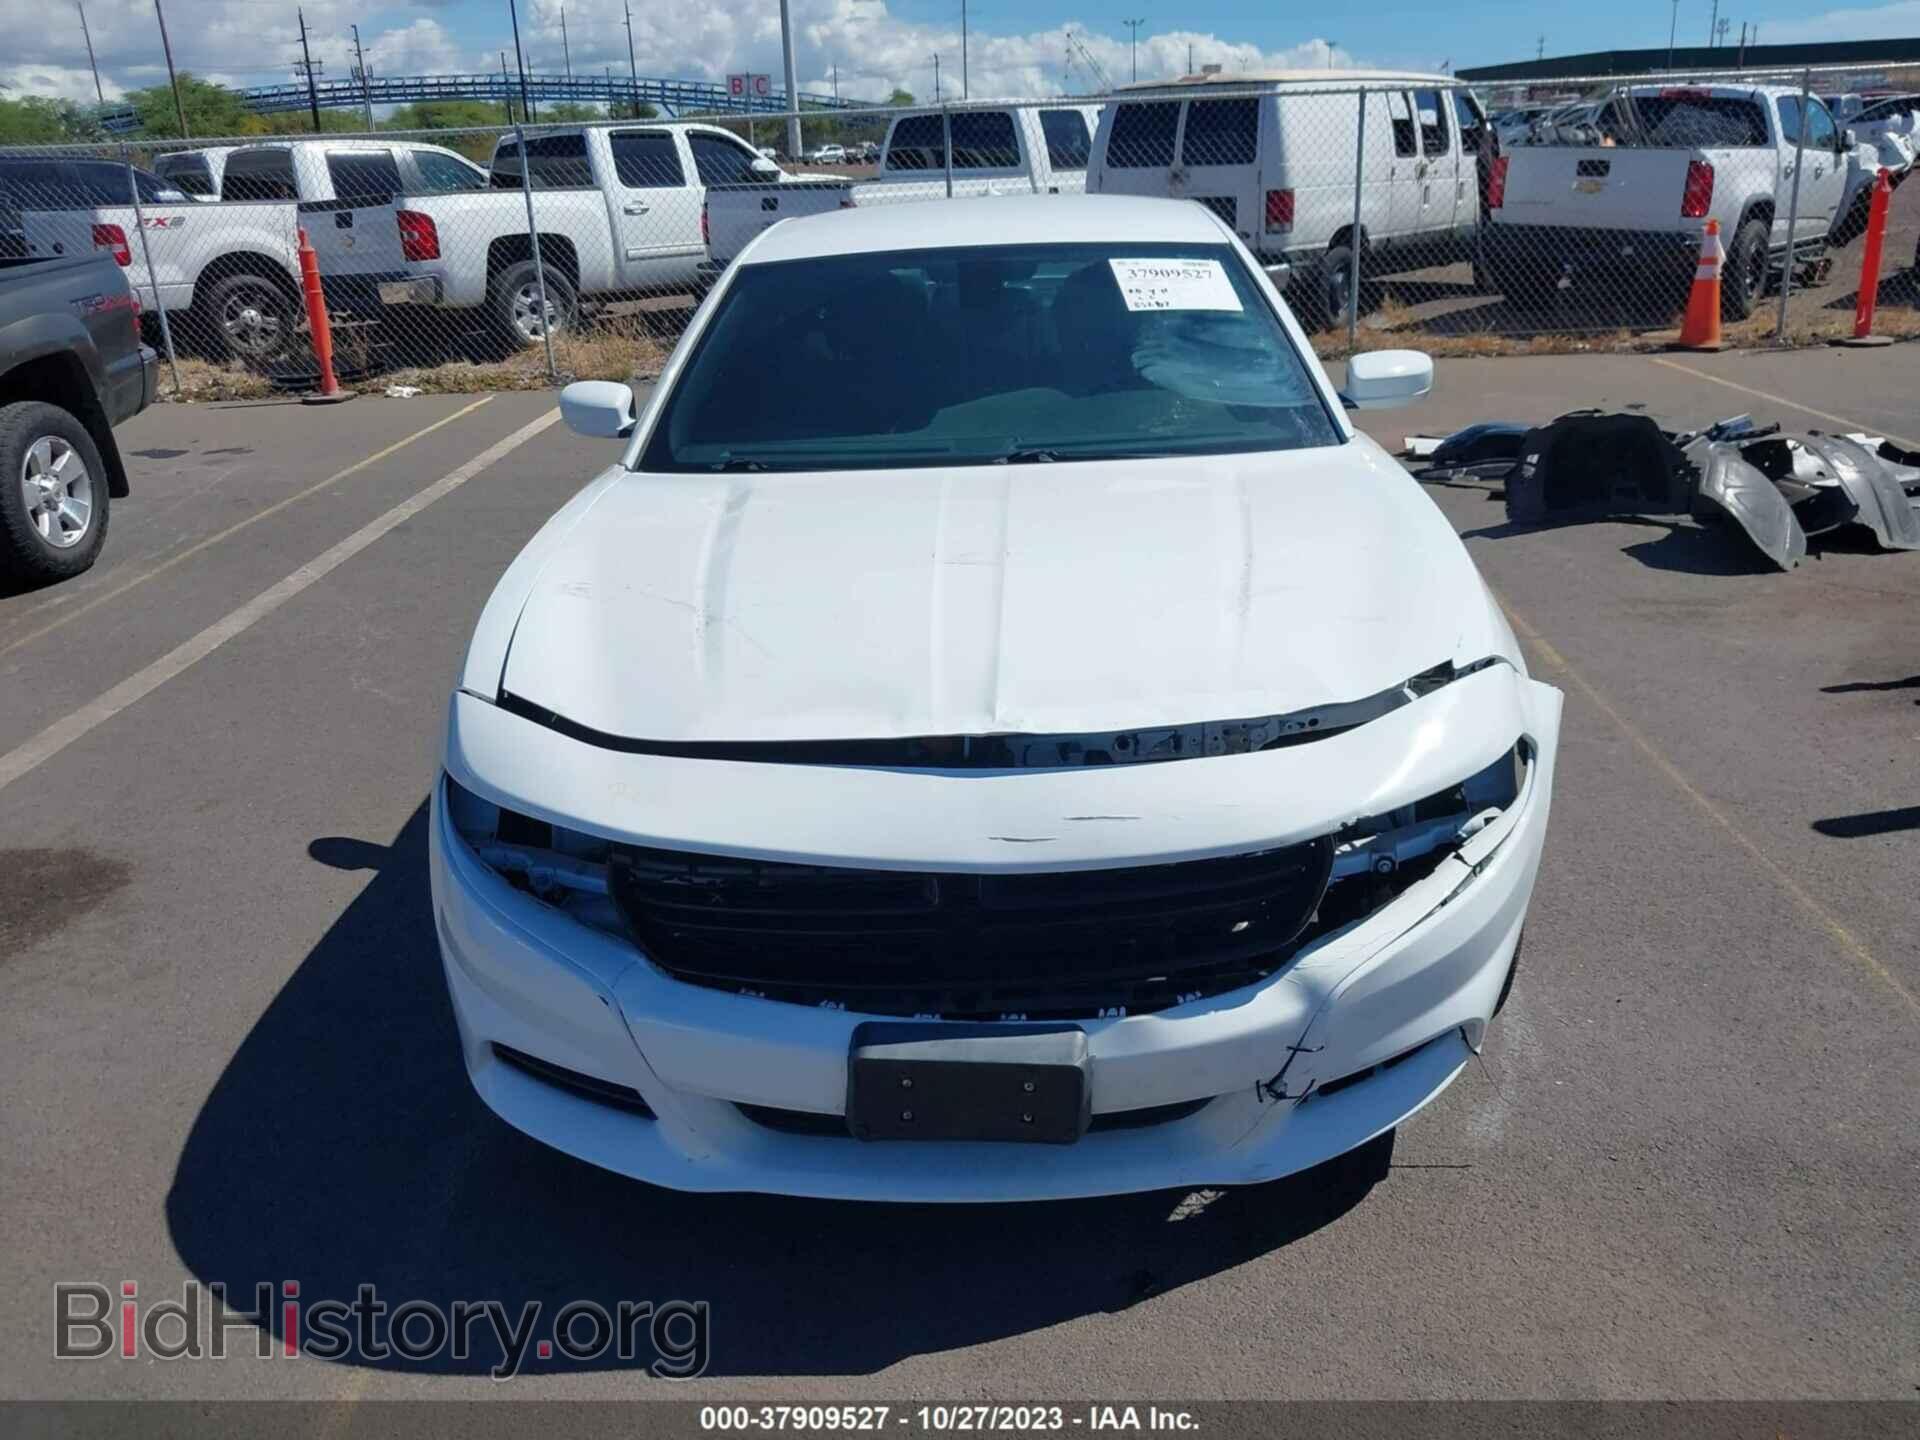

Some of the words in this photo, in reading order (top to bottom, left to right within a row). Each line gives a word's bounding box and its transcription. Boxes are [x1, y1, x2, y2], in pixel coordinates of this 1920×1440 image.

[731, 78, 743, 95] B
[756, 77, 768, 95] C
[1128, 268, 1212, 279] 37909527
